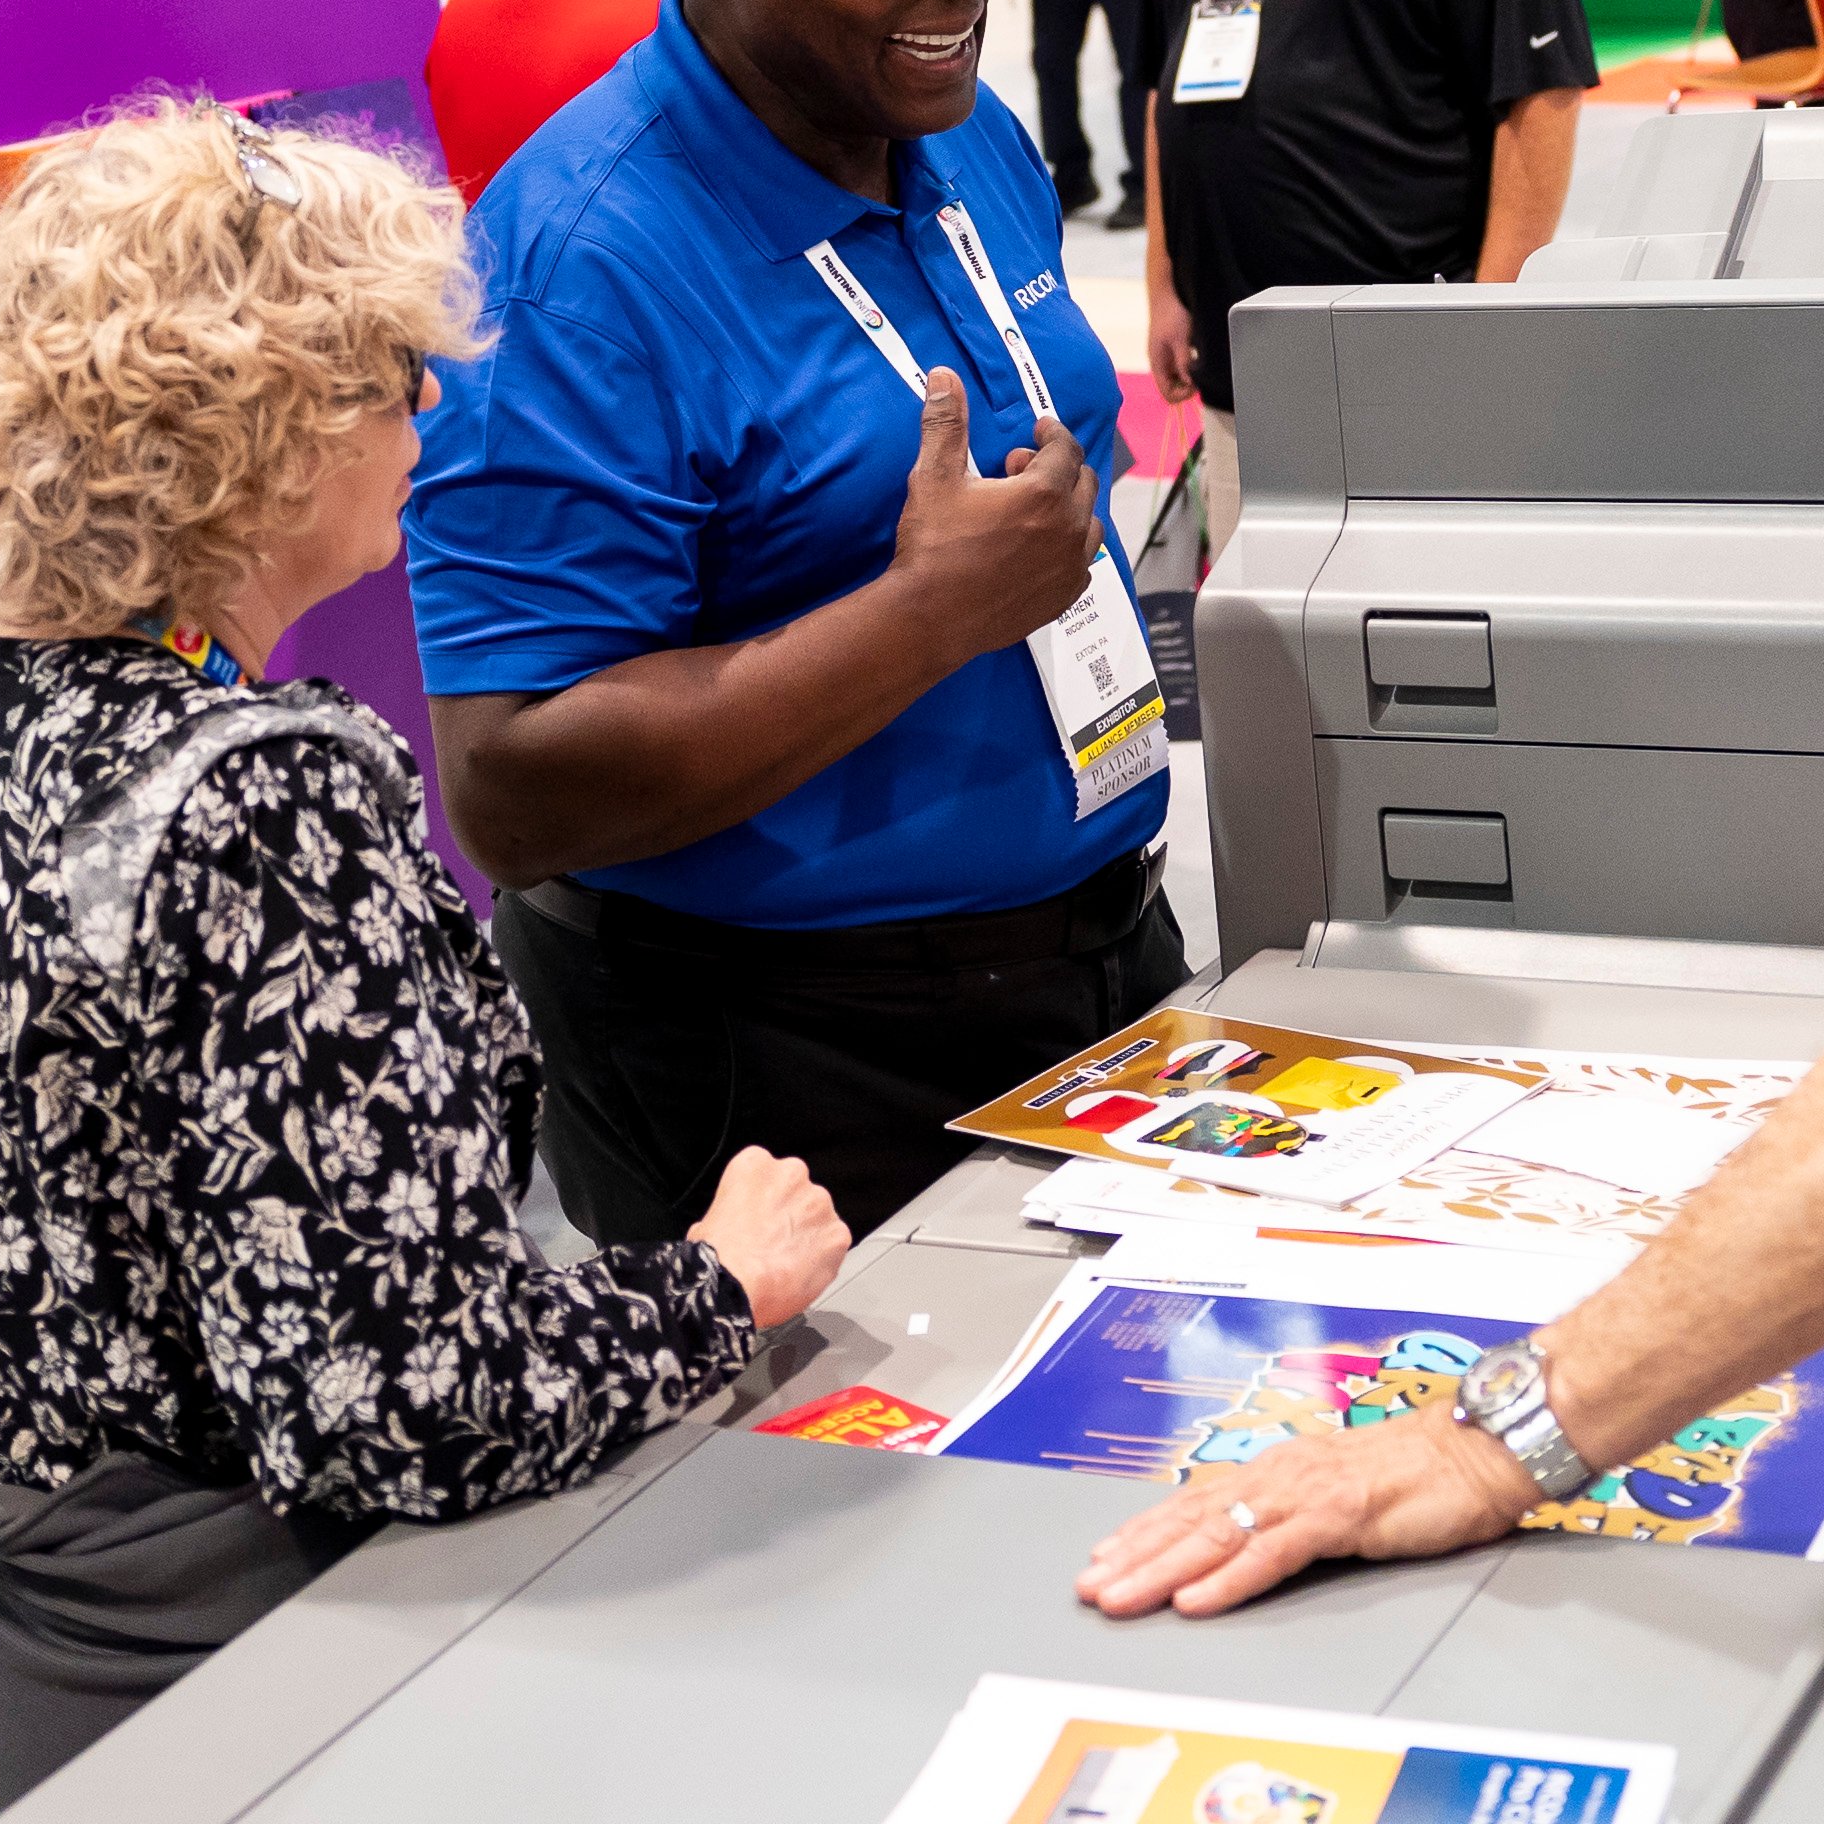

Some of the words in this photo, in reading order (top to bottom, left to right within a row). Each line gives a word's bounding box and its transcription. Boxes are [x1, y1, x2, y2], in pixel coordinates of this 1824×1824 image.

[1012, 268, 1059, 310] RICOH
[1057, 594, 1096, 626] MATHENY
[1065, 619, 1086, 637] RICOH
[1086, 611, 1100, 624] USA
[1098, 637, 1109, 648] PA
[1095, 697, 1138, 735] EXHIBITOR
[1087, 729, 1125, 763] ALLIANCE
[1123, 705, 1158, 735] MEMBER
[1091, 734, 1153, 786] PLATINUM
[1096, 755, 1152, 801] SPONSOR
[1098, 1041, 1149, 1071] CAROUSEL
[1033, 1075, 1090, 1107] CLOTHING
